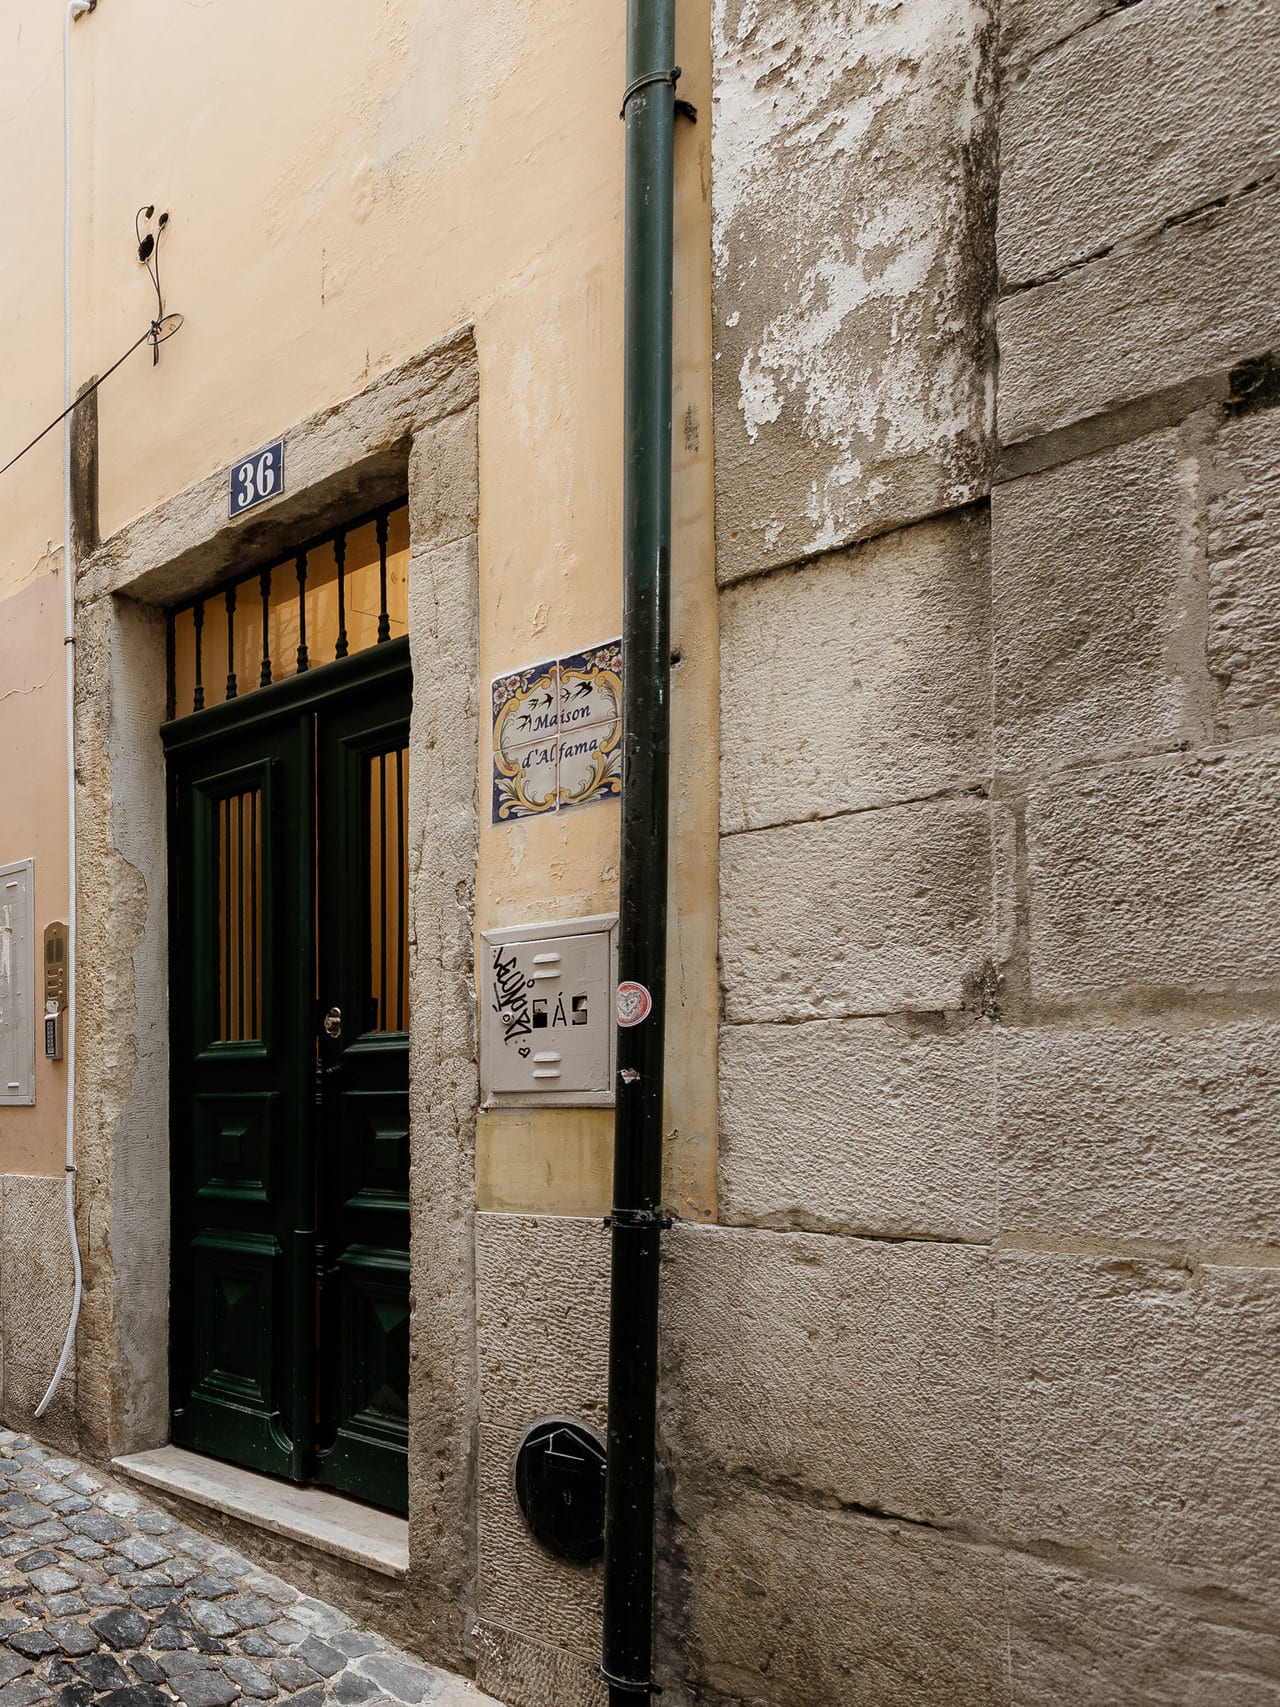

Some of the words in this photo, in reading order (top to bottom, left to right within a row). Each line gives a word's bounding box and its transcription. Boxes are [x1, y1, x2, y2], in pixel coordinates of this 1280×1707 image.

[237, 452, 275, 507] 36
[533, 705, 591, 731] Maison
[522, 738, 599, 768] d'Alfama
[533, 992, 588, 1029] GÁS
